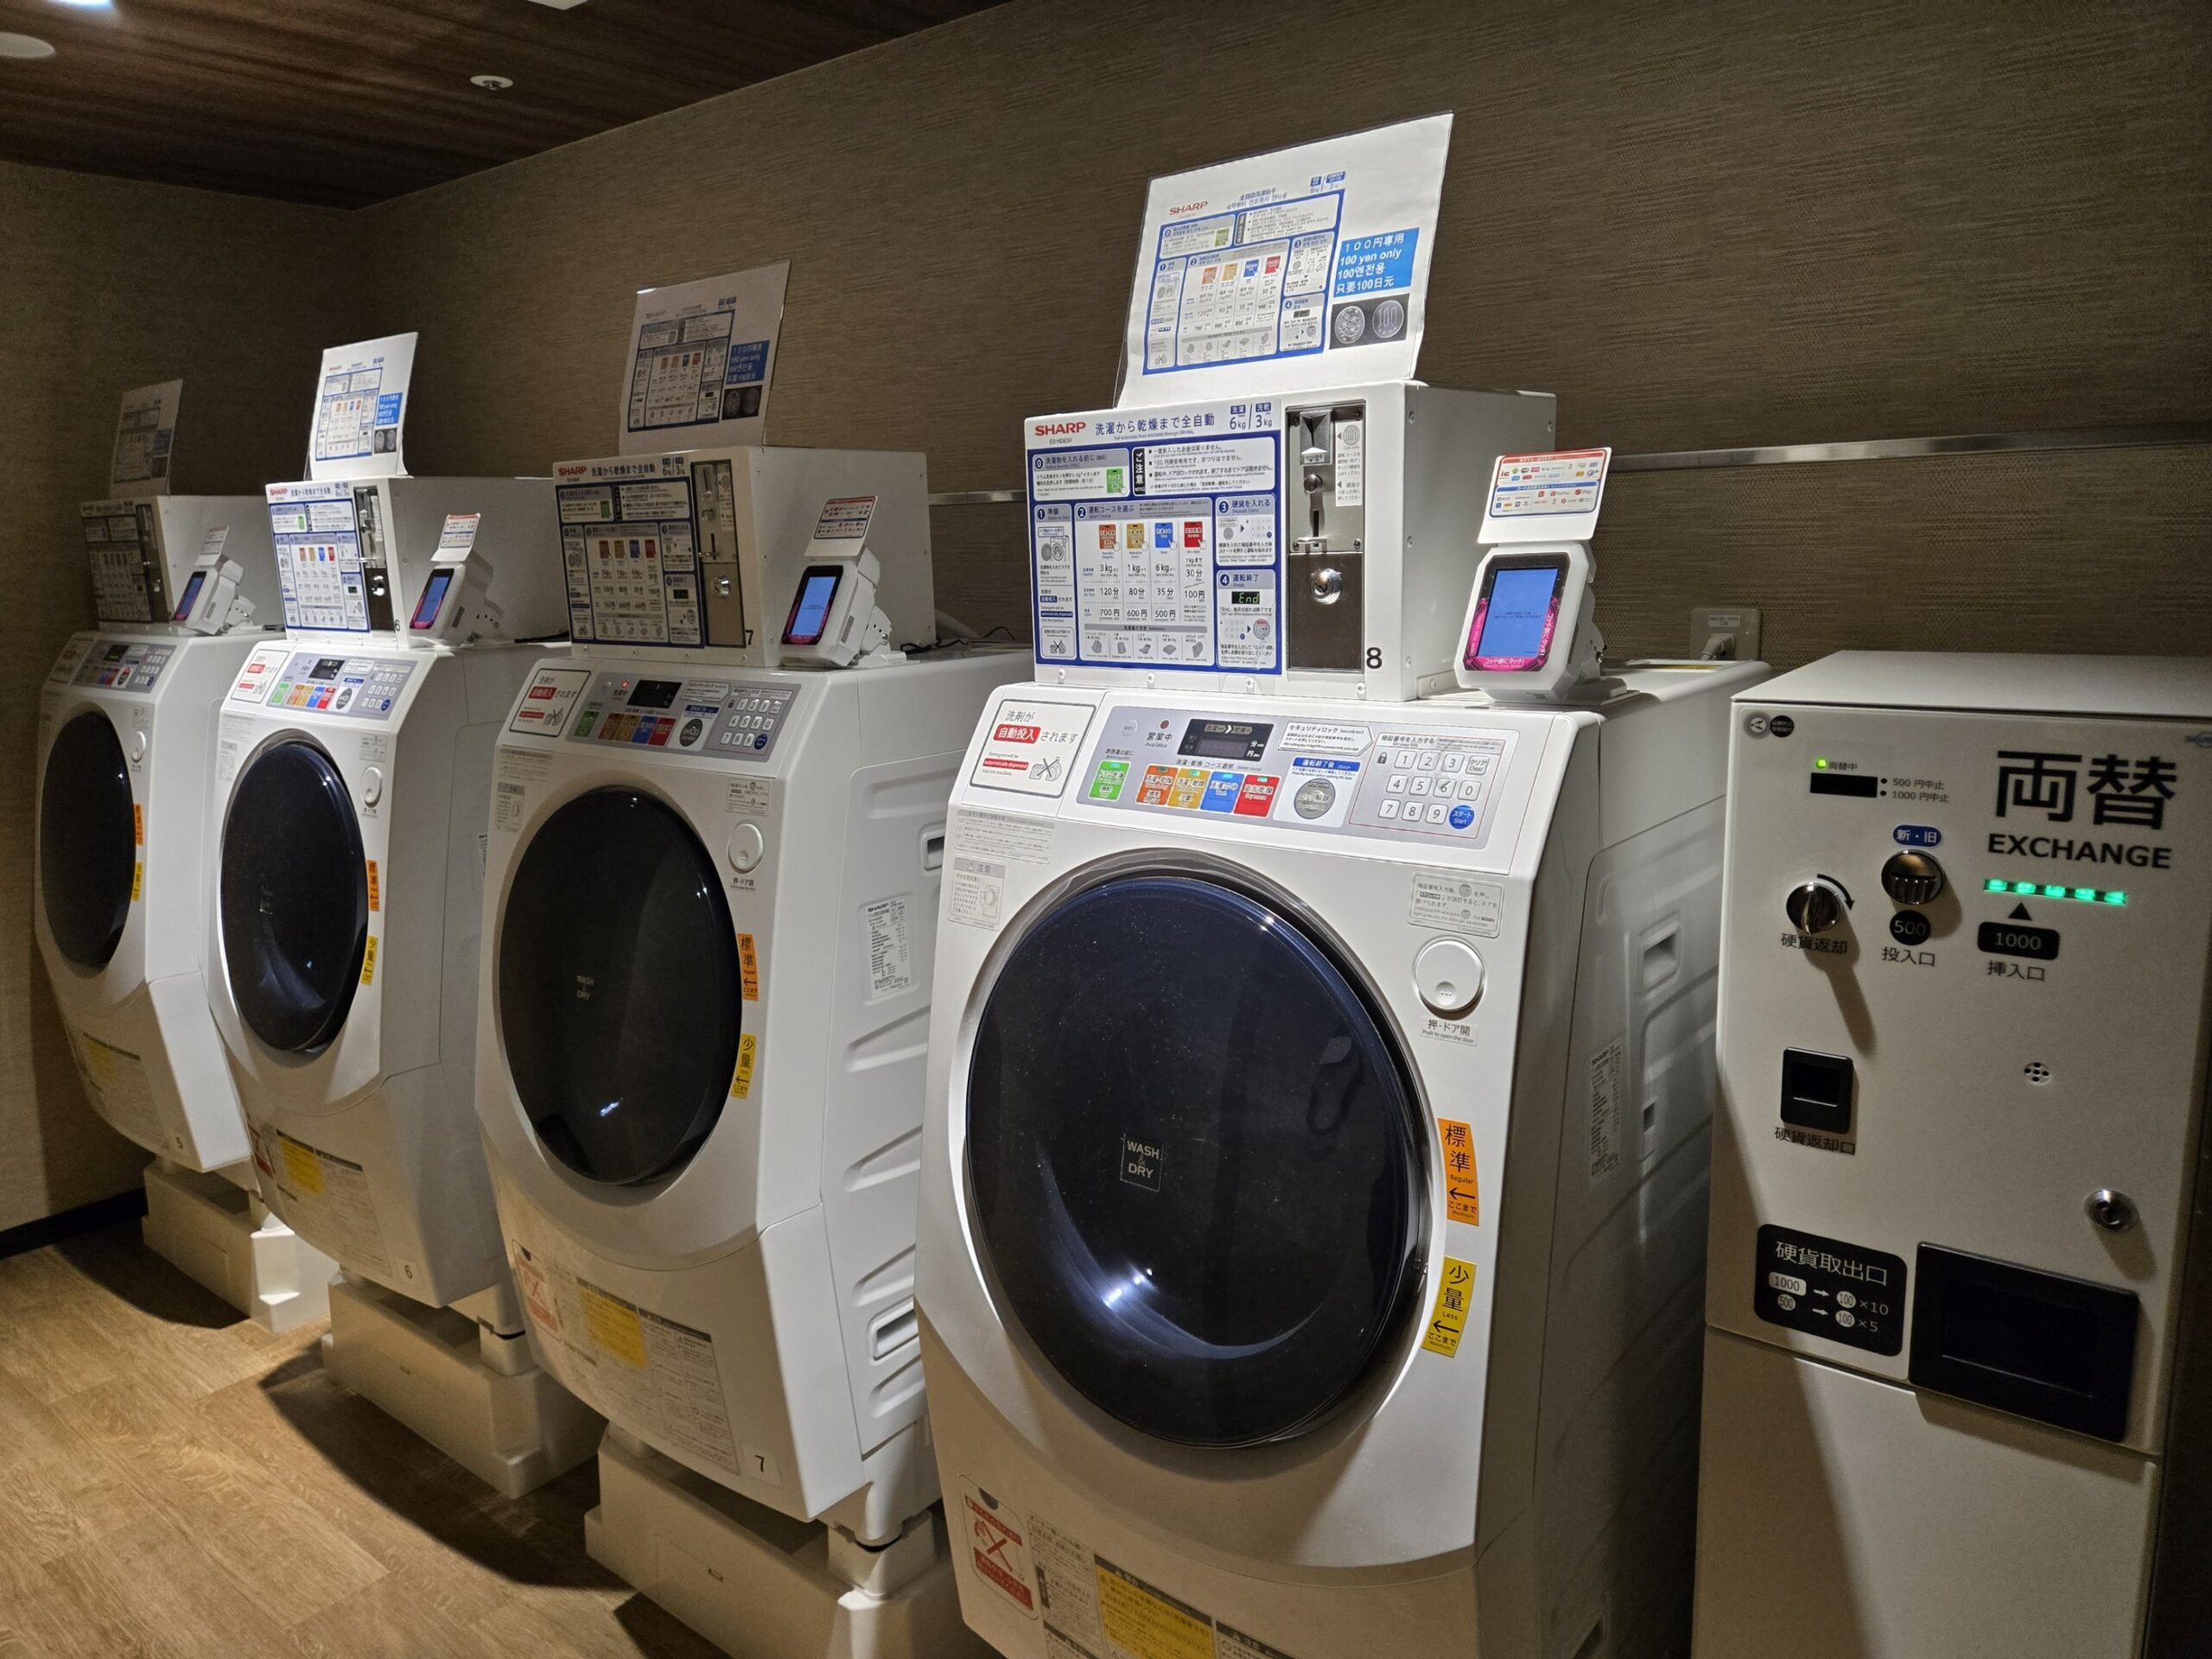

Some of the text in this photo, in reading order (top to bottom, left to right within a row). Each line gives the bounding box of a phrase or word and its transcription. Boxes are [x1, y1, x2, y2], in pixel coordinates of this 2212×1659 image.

[1169, 201, 1208, 215] SHARP
[1340, 248, 1402, 266] 100 yen only
[1338, 263, 1385, 279] 100엔전용
[1336, 276, 1395, 294] 只要100日元
[1035, 422, 1086, 436] SHARP
[1096, 412, 1215, 435] 洗濯から乾燥まで全自動
[1230, 414, 1272, 430] 6kg 3kg
[1046, 454, 1095, 464] 洗濯物を入れる前に
[558, 466, 587, 477] SHARP
[1088, 504, 1135, 513] 運転コースを選ぶ
[1232, 499, 1270, 508] 硬貨を入れる
[1185, 569, 1202, 578] 30分
[1233, 574, 1259, 582] 運転終了
[1157, 588, 1173, 596] 35分
[1185, 590, 1205, 599] 100円
[1238, 593, 1259, 604] End
[1100, 608, 1120, 617] 700円
[1155, 609, 1175, 618] 500円
[395, 619, 401, 632] 6
[746, 629, 753, 646] 7
[1366, 646, 1382, 669] 8
[1005, 709, 1035, 723] 洗剤が
[998, 727, 1078, 744] 自動投入 されます
[1147, 732, 1173, 741] 営業中
[1290, 725, 1338, 734] セキュリティロック
[1382, 734, 1434, 744] 暗証番号を入力する
[1302, 760, 1335, 768] 運転終了後
[1425, 757, 1432, 766] 2
[1448, 759, 1455, 767] 3
[1828, 761, 1859, 771] 両替中
[1210, 781, 1238, 790] 洗濯のみ
[1245, 785, 1273, 794] 追加乾燥
[1393, 779, 1473, 795] 4 5 6 0
[1893, 778, 1944, 790] 500 円中止
[1996, 750, 2177, 830] 両替
[1892, 791, 1949, 803] 1000 円中止
[1386, 804, 1393, 814] 7
[1408, 806, 1416, 817] 8
[1433, 809, 1440, 818] 9
[1897, 829, 1937, 843] 新・旧
[1988, 834, 2171, 871] EXCHANGE
[868, 902, 889, 912] SHARP
[1893, 919, 1927, 937] 500
[1781, 932, 1848, 956] 硬貨返却
[1994, 931, 2042, 951] 1000
[741, 937, 754, 968] 標準
[1882, 947, 1936, 968] 投入口
[1987, 960, 2046, 982] 挿入口
[740, 1037, 753, 1069] 少量
[176, 1137, 183, 1149] 5
[1774, 1126, 1857, 1156] 硬貨返却口
[1127, 1141, 1160, 1160] WASH
[1445, 1124, 1471, 1173] 標準
[1138, 1154, 1146, 1166] &
[1128, 1162, 1154, 1179] DRY
[1450, 1174, 1473, 1185] Regular
[1448, 1201, 1478, 1214] ここまで
[1452, 1210, 1474, 1219] Maximum
[1775, 1240, 1888, 1287] 硬貨取出口
[404, 1264, 413, 1280] 6
[1443, 1265, 1469, 1313] 少量
[1774, 1274, 1801, 1293] 1000
[1838, 1293, 1854, 1307] 100
[1442, 1311, 1459, 1320] Less
[1777, 1295, 1795, 1311] 500
[1837, 1311, 1853, 1326] 100
[1428, 1332, 1457, 1347] ここまで
[1429, 1340, 1452, 1351] Maximum
[755, 1454, 765, 1472] 7
